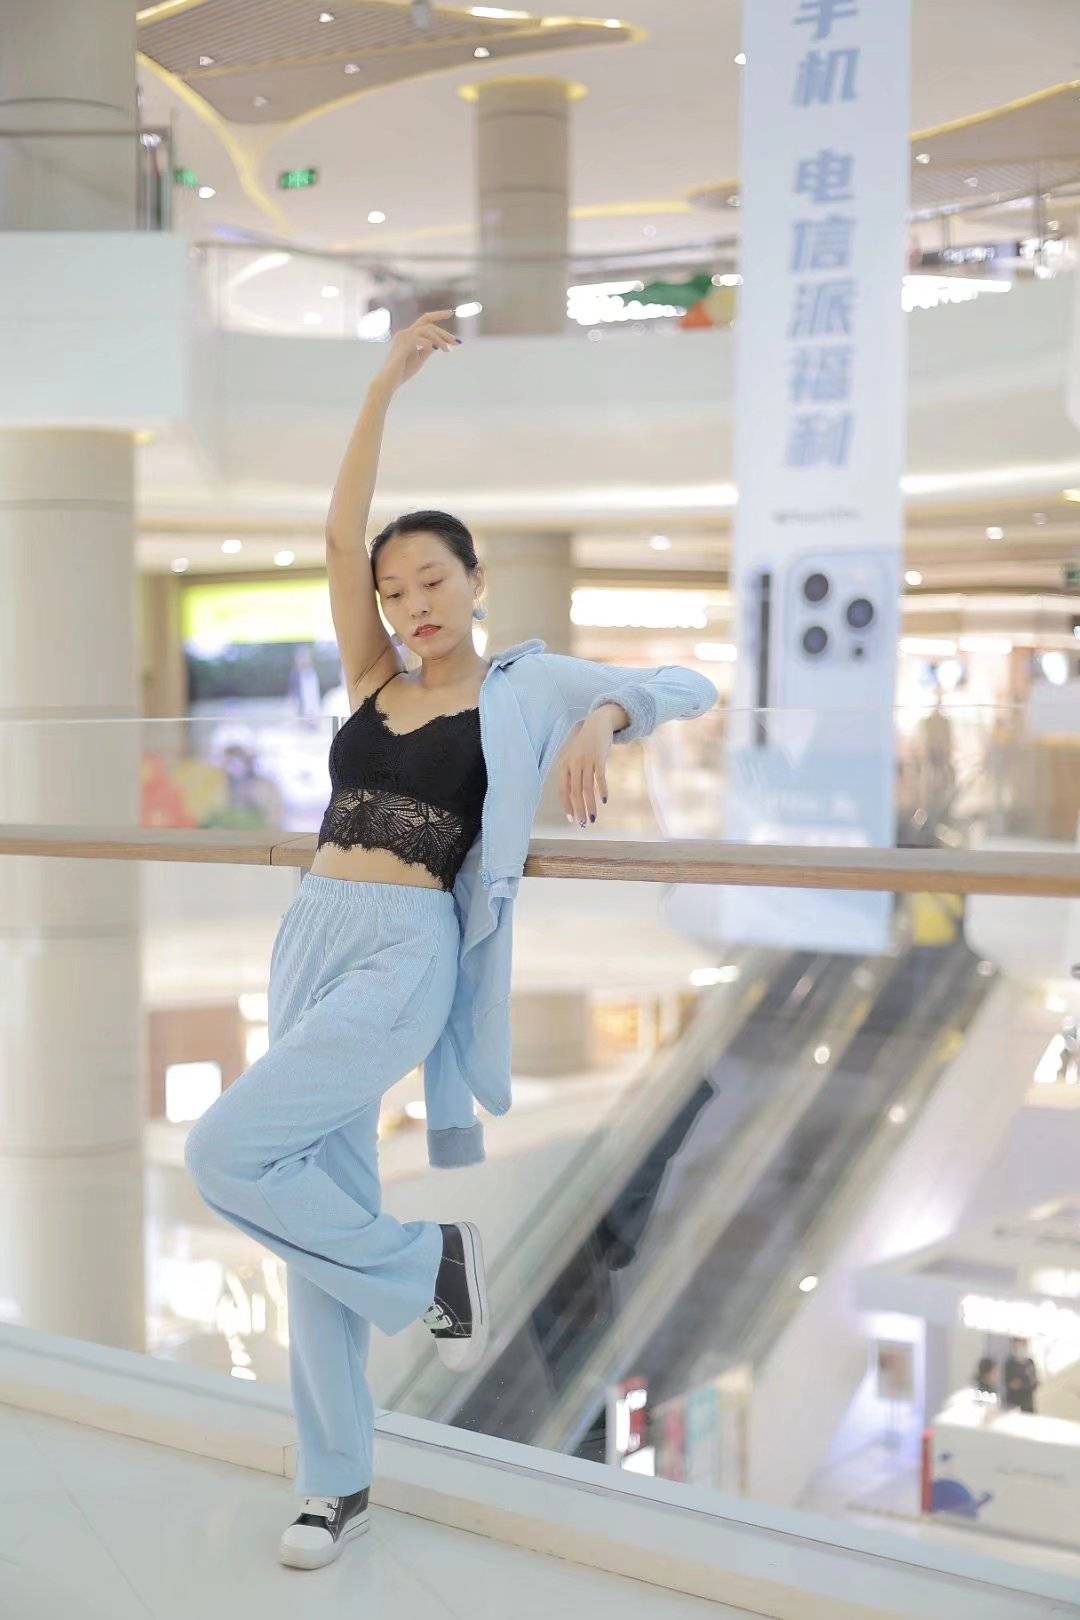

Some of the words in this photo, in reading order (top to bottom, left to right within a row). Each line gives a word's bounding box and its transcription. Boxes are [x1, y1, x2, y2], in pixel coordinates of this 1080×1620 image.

[786, 148, 857, 469] 电信派福利
